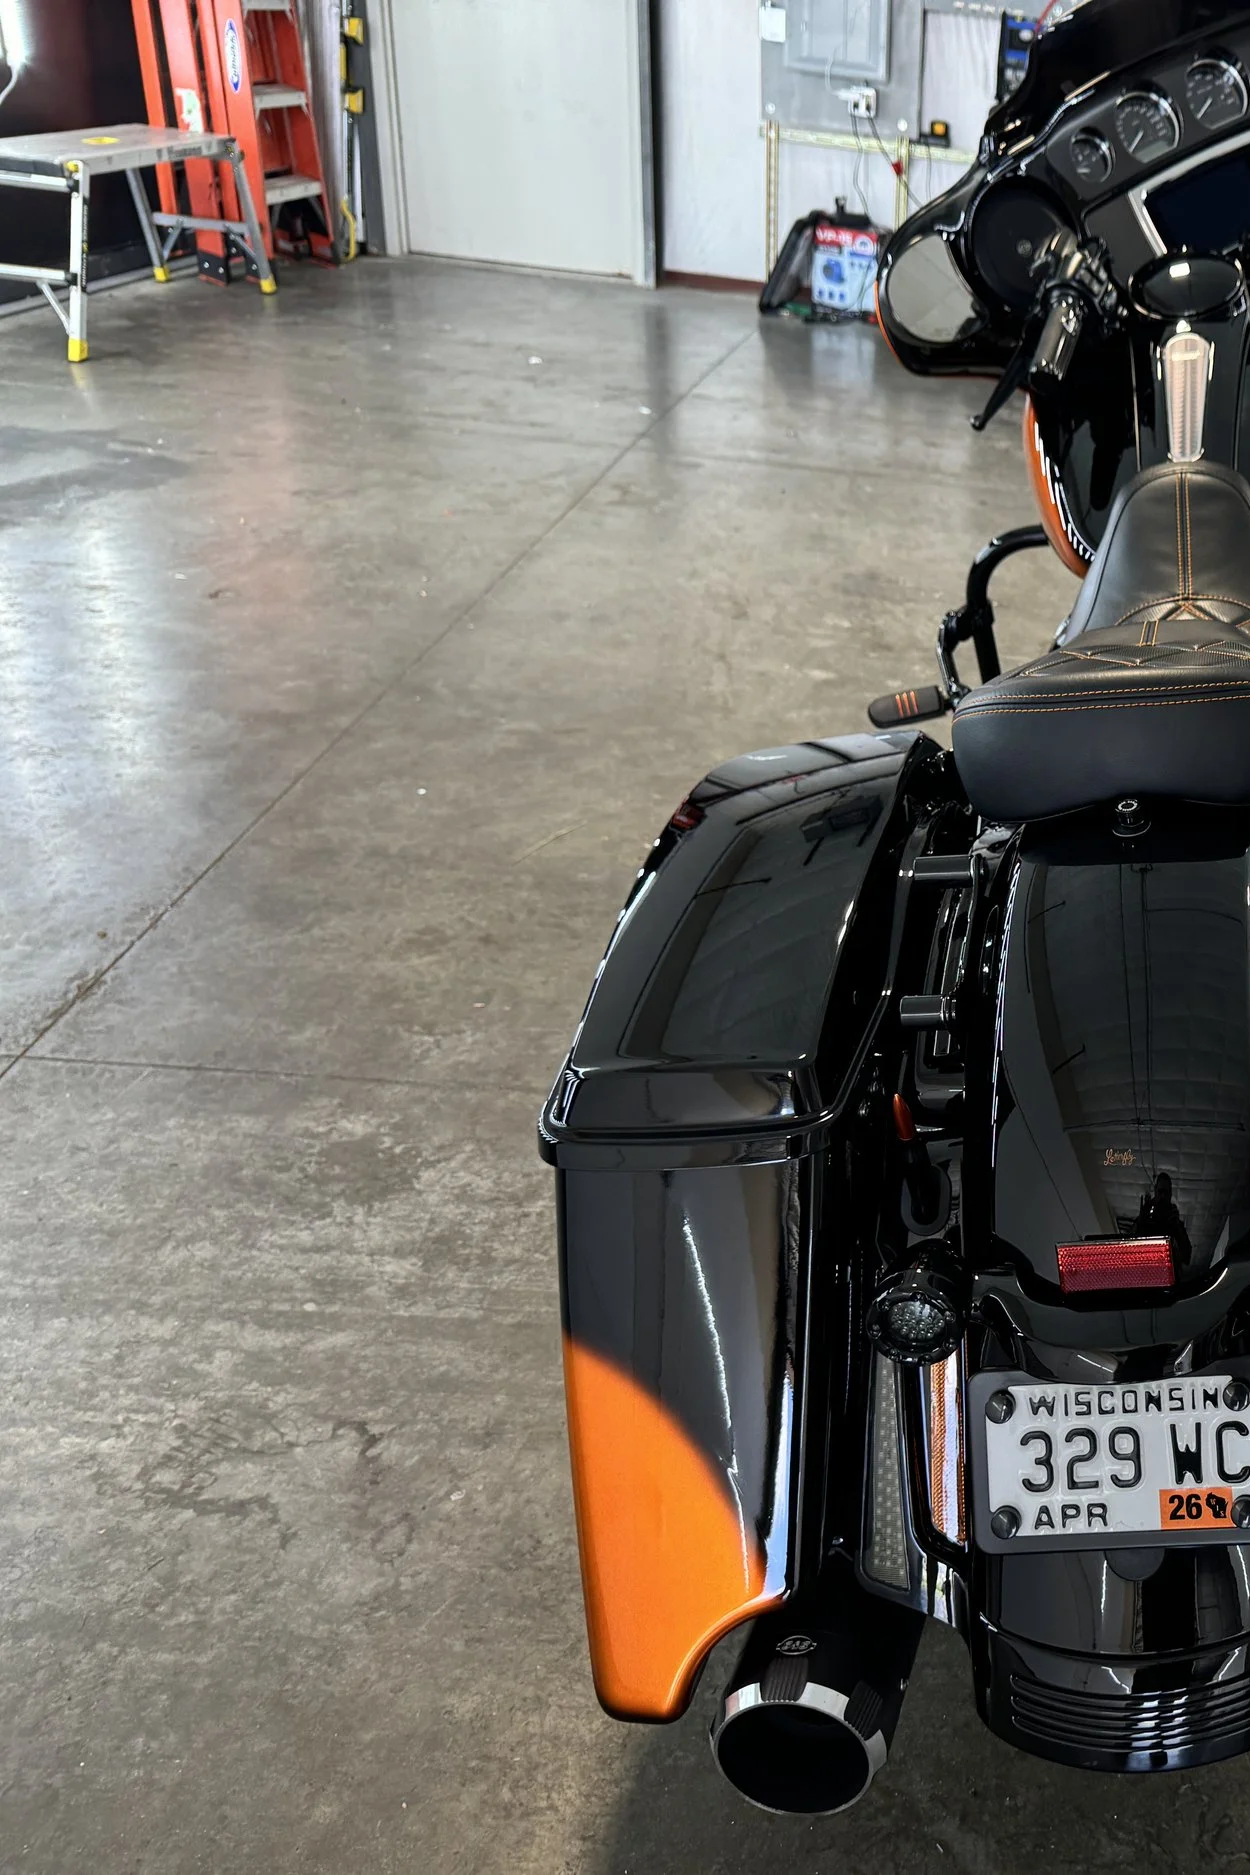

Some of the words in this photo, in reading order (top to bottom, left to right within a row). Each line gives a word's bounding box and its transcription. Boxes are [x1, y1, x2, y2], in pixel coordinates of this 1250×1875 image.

[1029, 1387, 1219, 1416] WISCONSIN
[1019, 1425, 1142, 1492] 329
[1034, 1502, 1108, 1530] APR
[1168, 1494, 1202, 1520] 26
